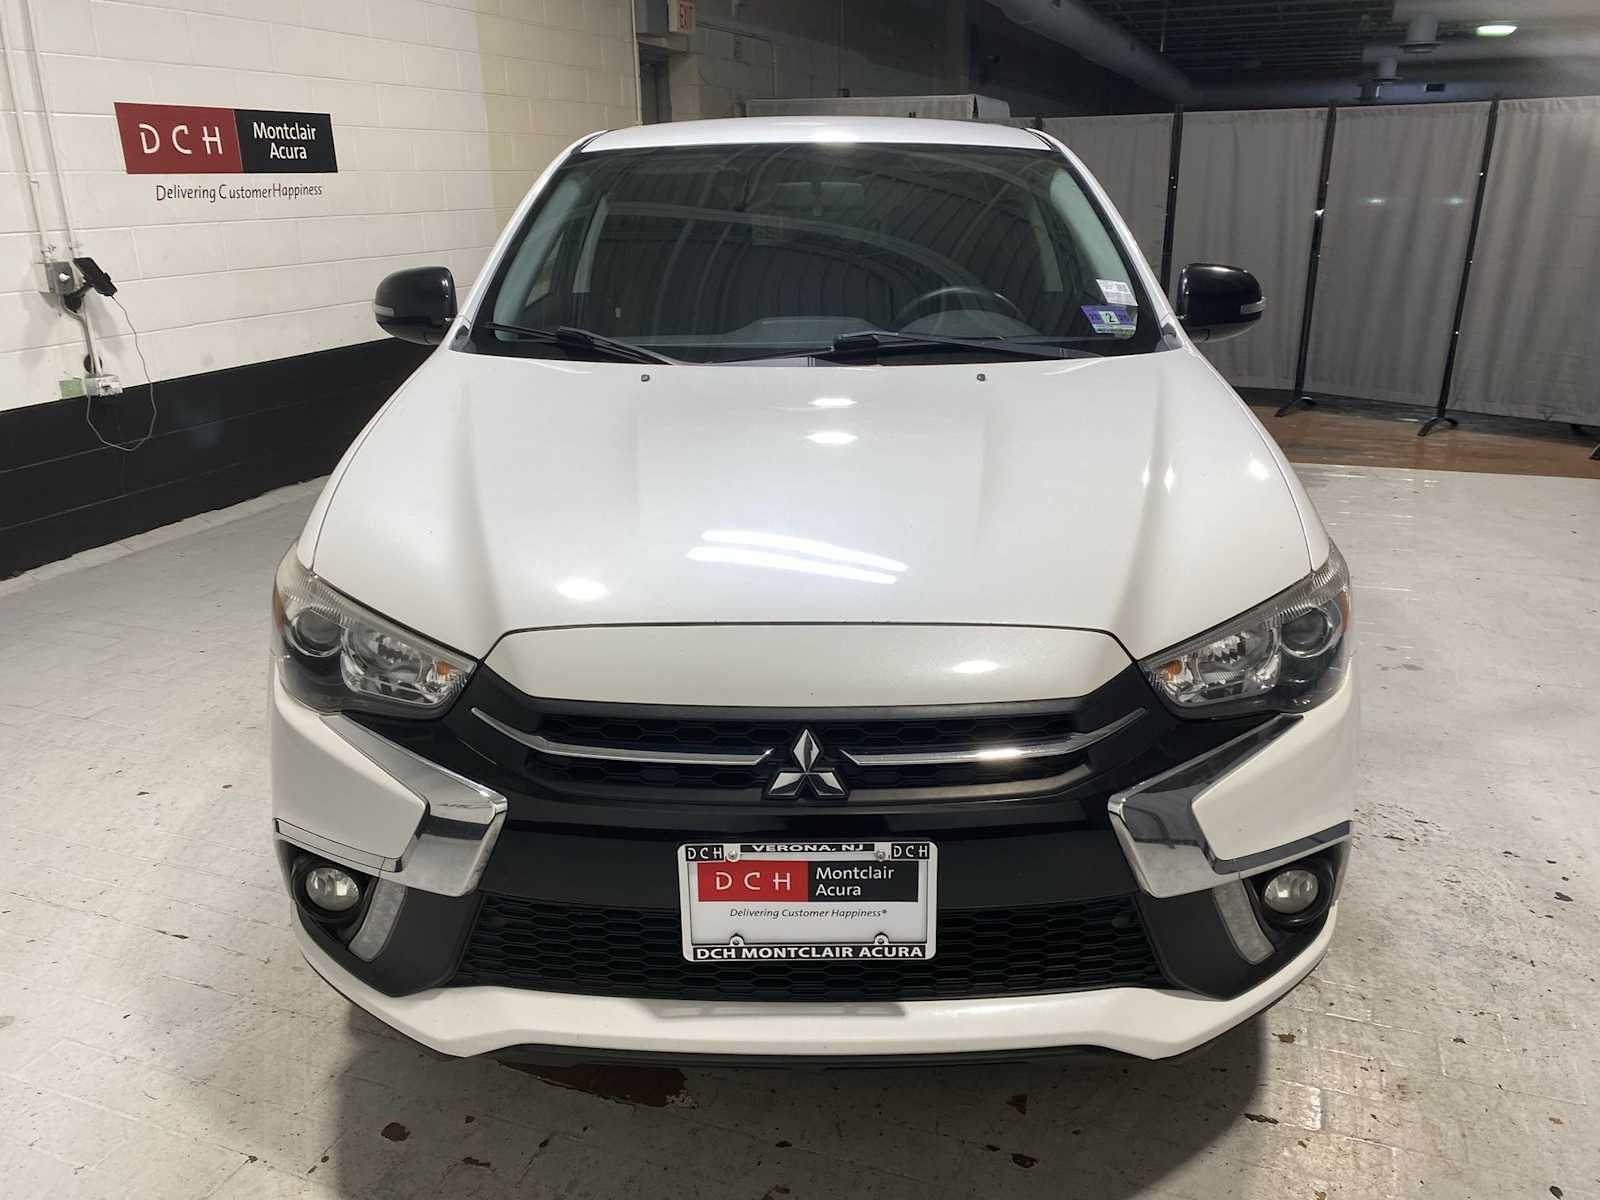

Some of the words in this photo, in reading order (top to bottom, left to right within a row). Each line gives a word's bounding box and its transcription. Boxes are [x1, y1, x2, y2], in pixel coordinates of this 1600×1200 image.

[253, 121, 317, 141] Montclair
[138, 123, 223, 155] DCH
[269, 142, 308, 160] Acura
[155, 184, 216, 203] Delivering
[687, 847, 723, 859] DCH
[893, 845, 928, 858] DCH
[815, 865, 895, 880] Montclair
[715, 872, 791, 890] DCH
[815, 883, 862, 896] Acura
[729, 908, 779, 920] Delivering
[781, 908, 829, 918] Customer
[696, 948, 737, 959] DCH
[741, 947, 854, 958] MONTCLAIR
[858, 946, 924, 958] ACURA
